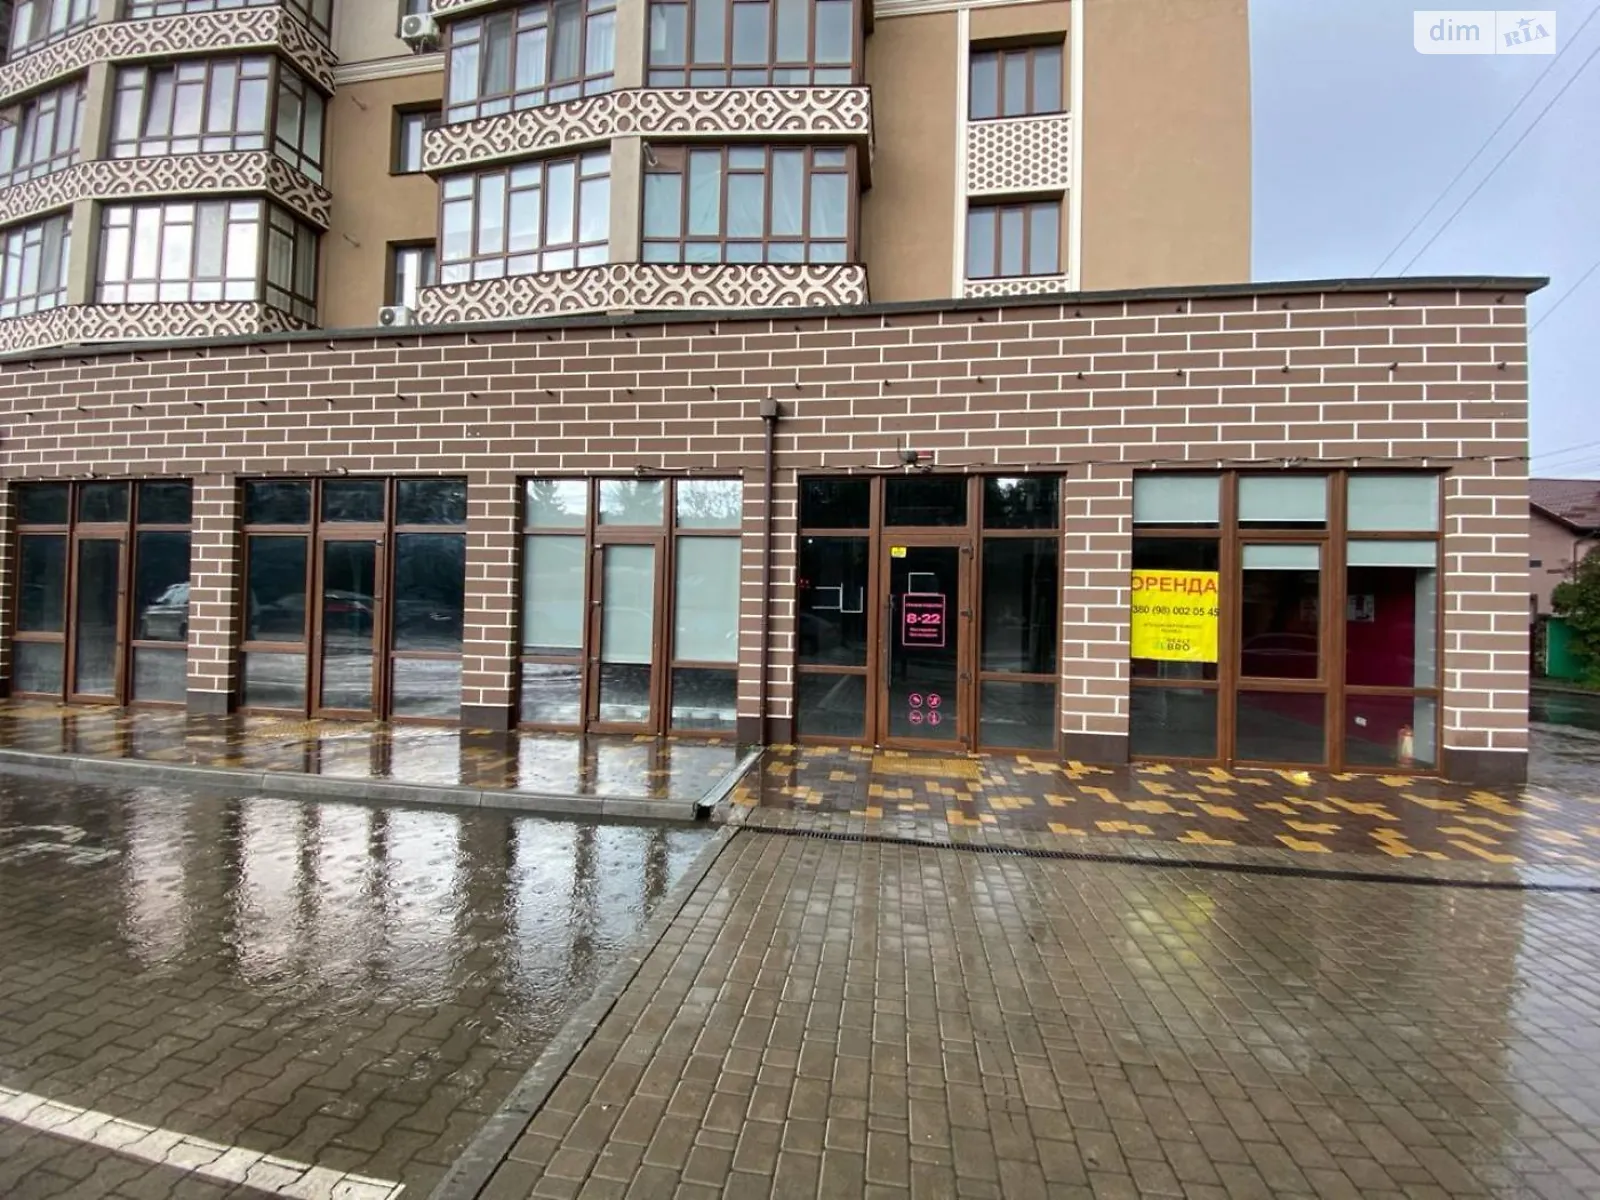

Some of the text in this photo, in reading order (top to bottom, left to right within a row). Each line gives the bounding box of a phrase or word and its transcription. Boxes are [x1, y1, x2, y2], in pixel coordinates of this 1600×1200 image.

[1131, 576, 1218, 596] ОРЕНДА
[1173, 606, 1191, 616] 002
[1193, 608, 1205, 617] 05
